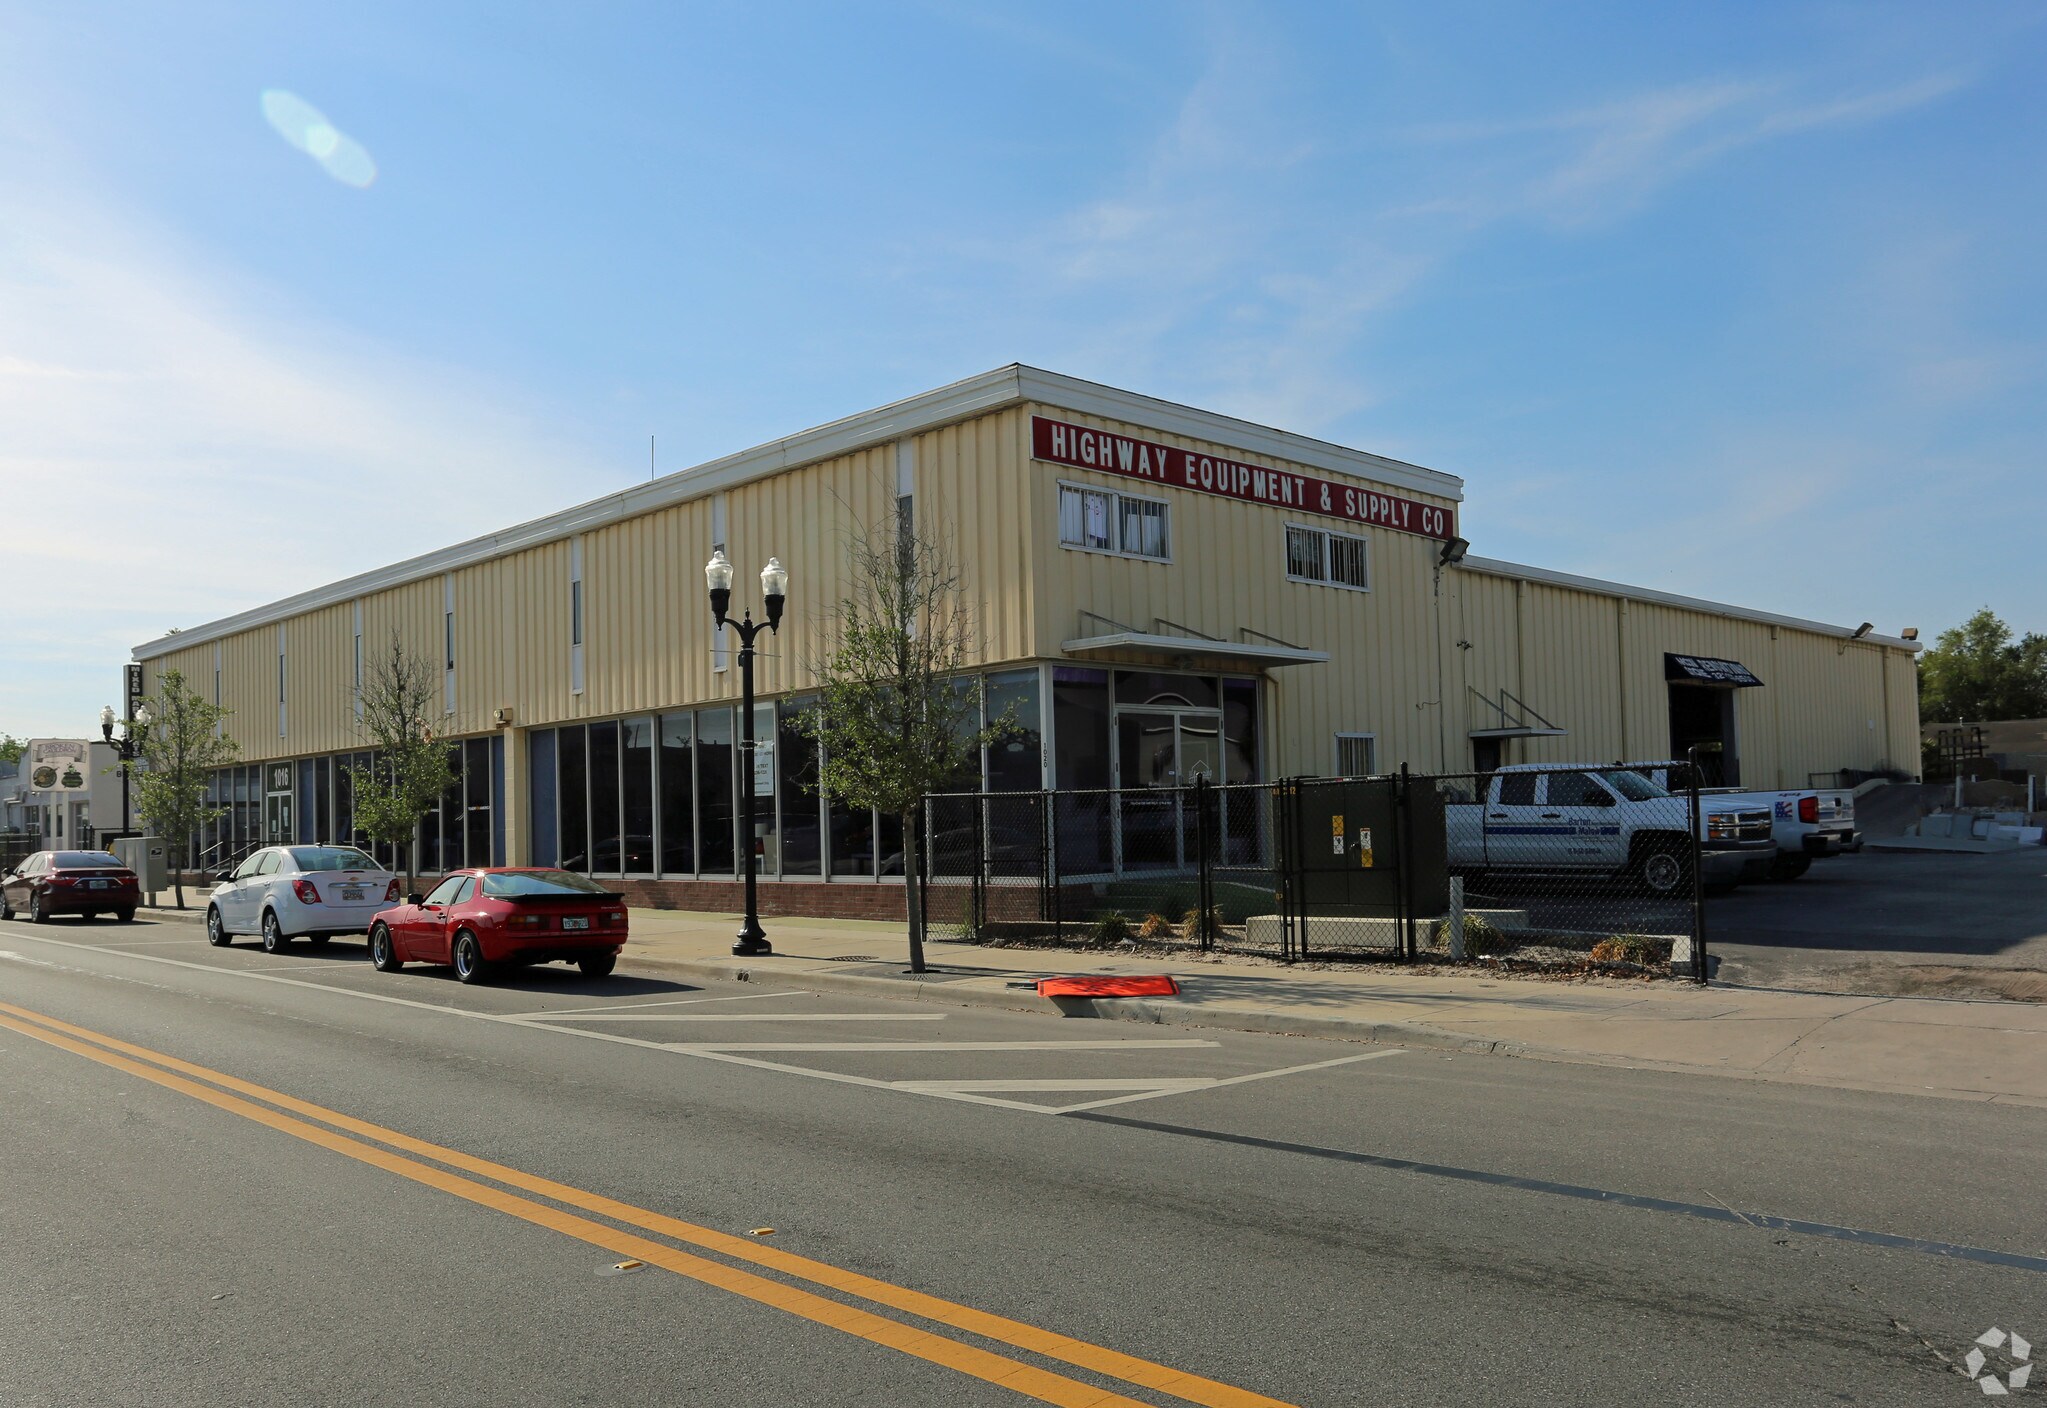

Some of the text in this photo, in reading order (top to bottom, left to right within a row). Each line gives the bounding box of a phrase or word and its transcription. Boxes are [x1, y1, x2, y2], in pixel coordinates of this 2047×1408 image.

[1051, 424, 1444, 535] HIGHWAY EQUIPMENT & SUPPLY CO
[131, 666, 140, 693] MIXED
[274, 768, 289, 788] 1016
